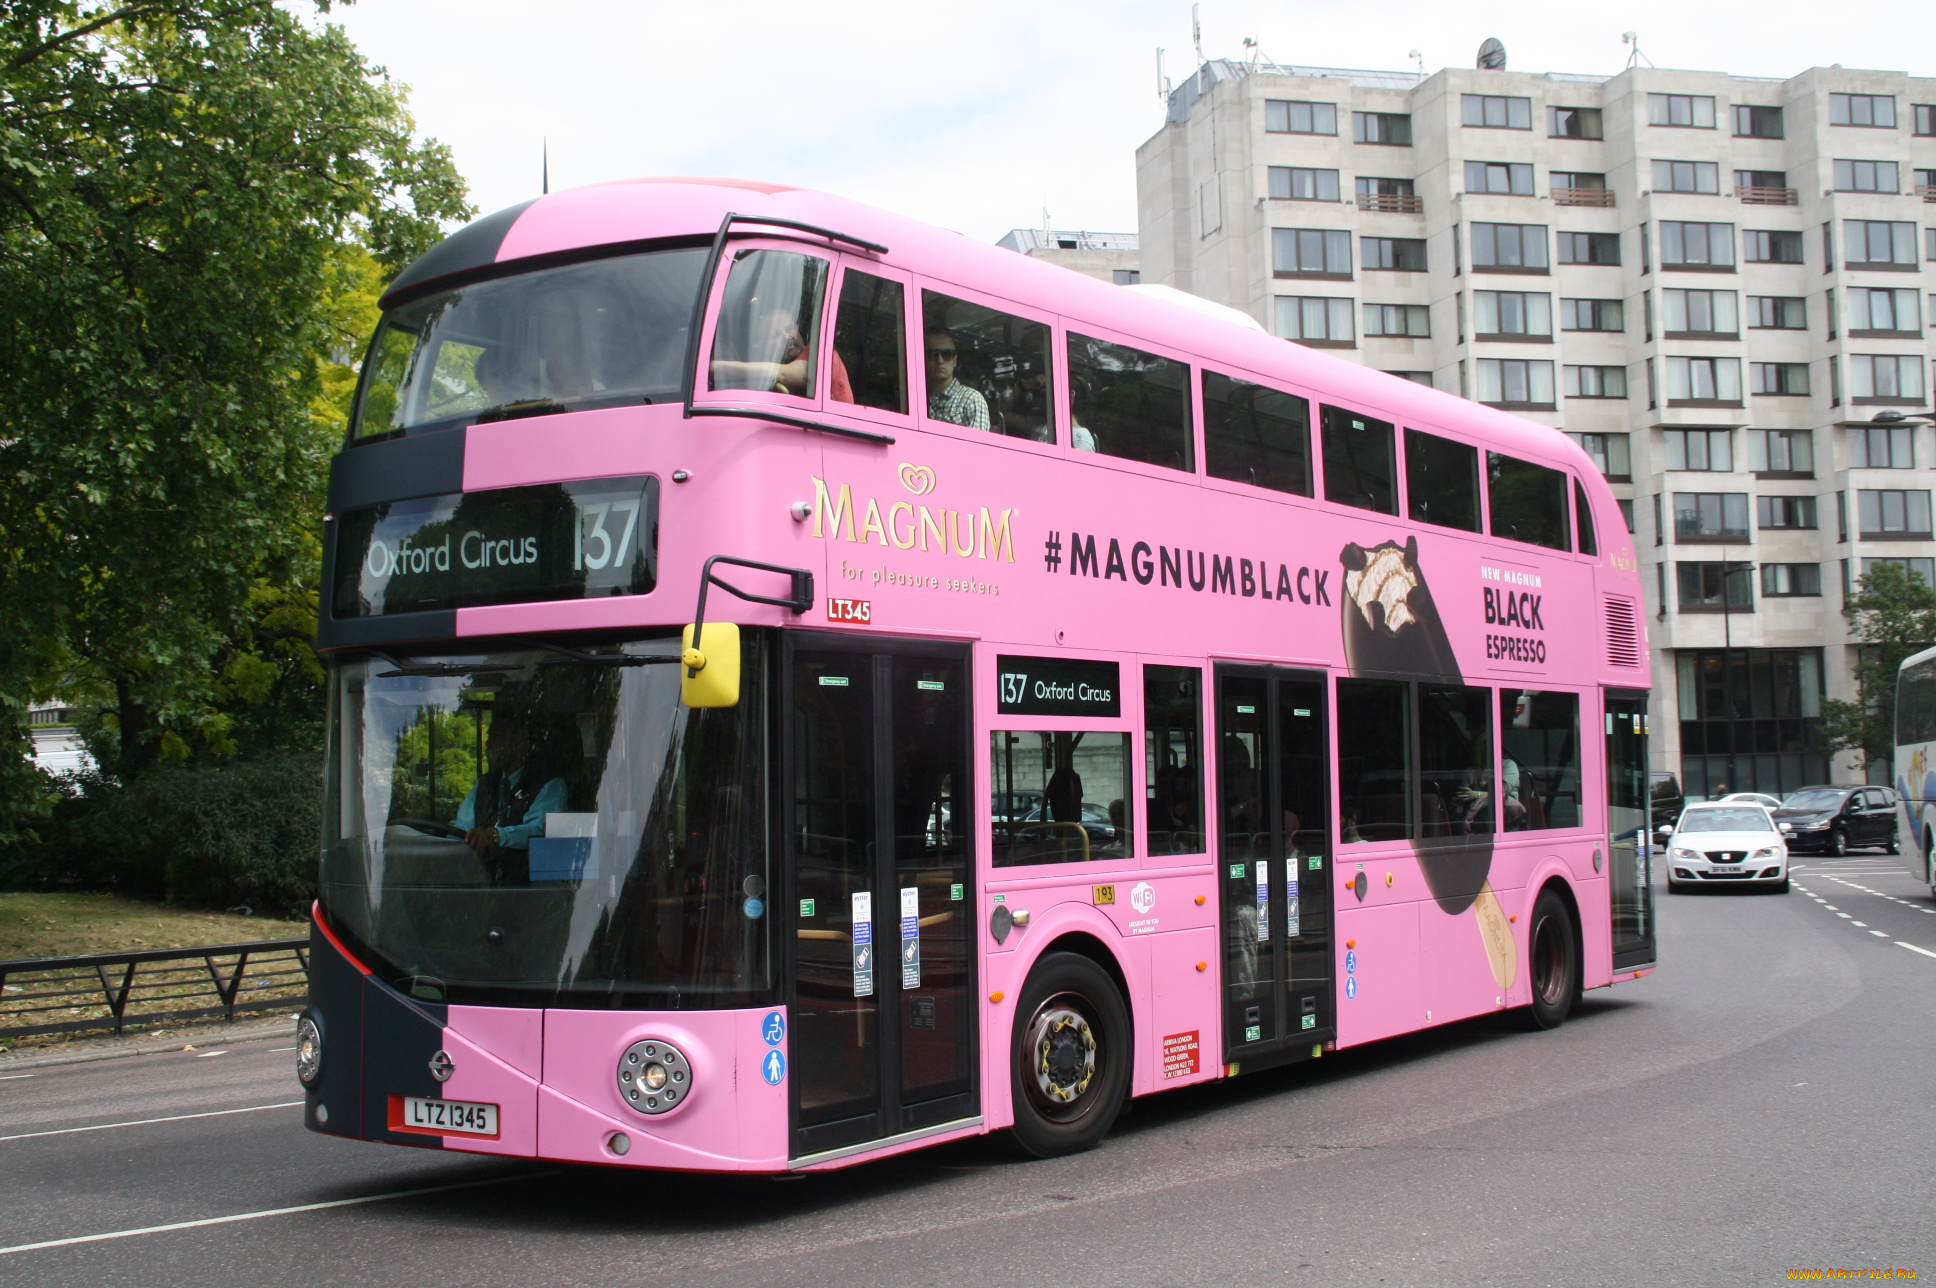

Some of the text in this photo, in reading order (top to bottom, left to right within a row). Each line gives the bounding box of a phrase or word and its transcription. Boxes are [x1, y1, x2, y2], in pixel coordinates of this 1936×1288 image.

[573, 501, 640, 571] 137
[811, 475, 1015, 563] MAGNUM
[367, 530, 538, 578] Oxford Circus
[1044, 530, 1332, 607] #MAGNUMBLACK
[840, 559, 1000, 596] for pleasure seekers
[1480, 566, 1542, 588] NEW MAGNUM
[828, 598, 870, 622] LT345
[1483, 586, 1545, 631] BLACK
[1486, 634, 1546, 664] ESPRESSO
[1000, 673, 1111, 704] 137 Oxford Circus
[1096, 887, 1113, 902] 193
